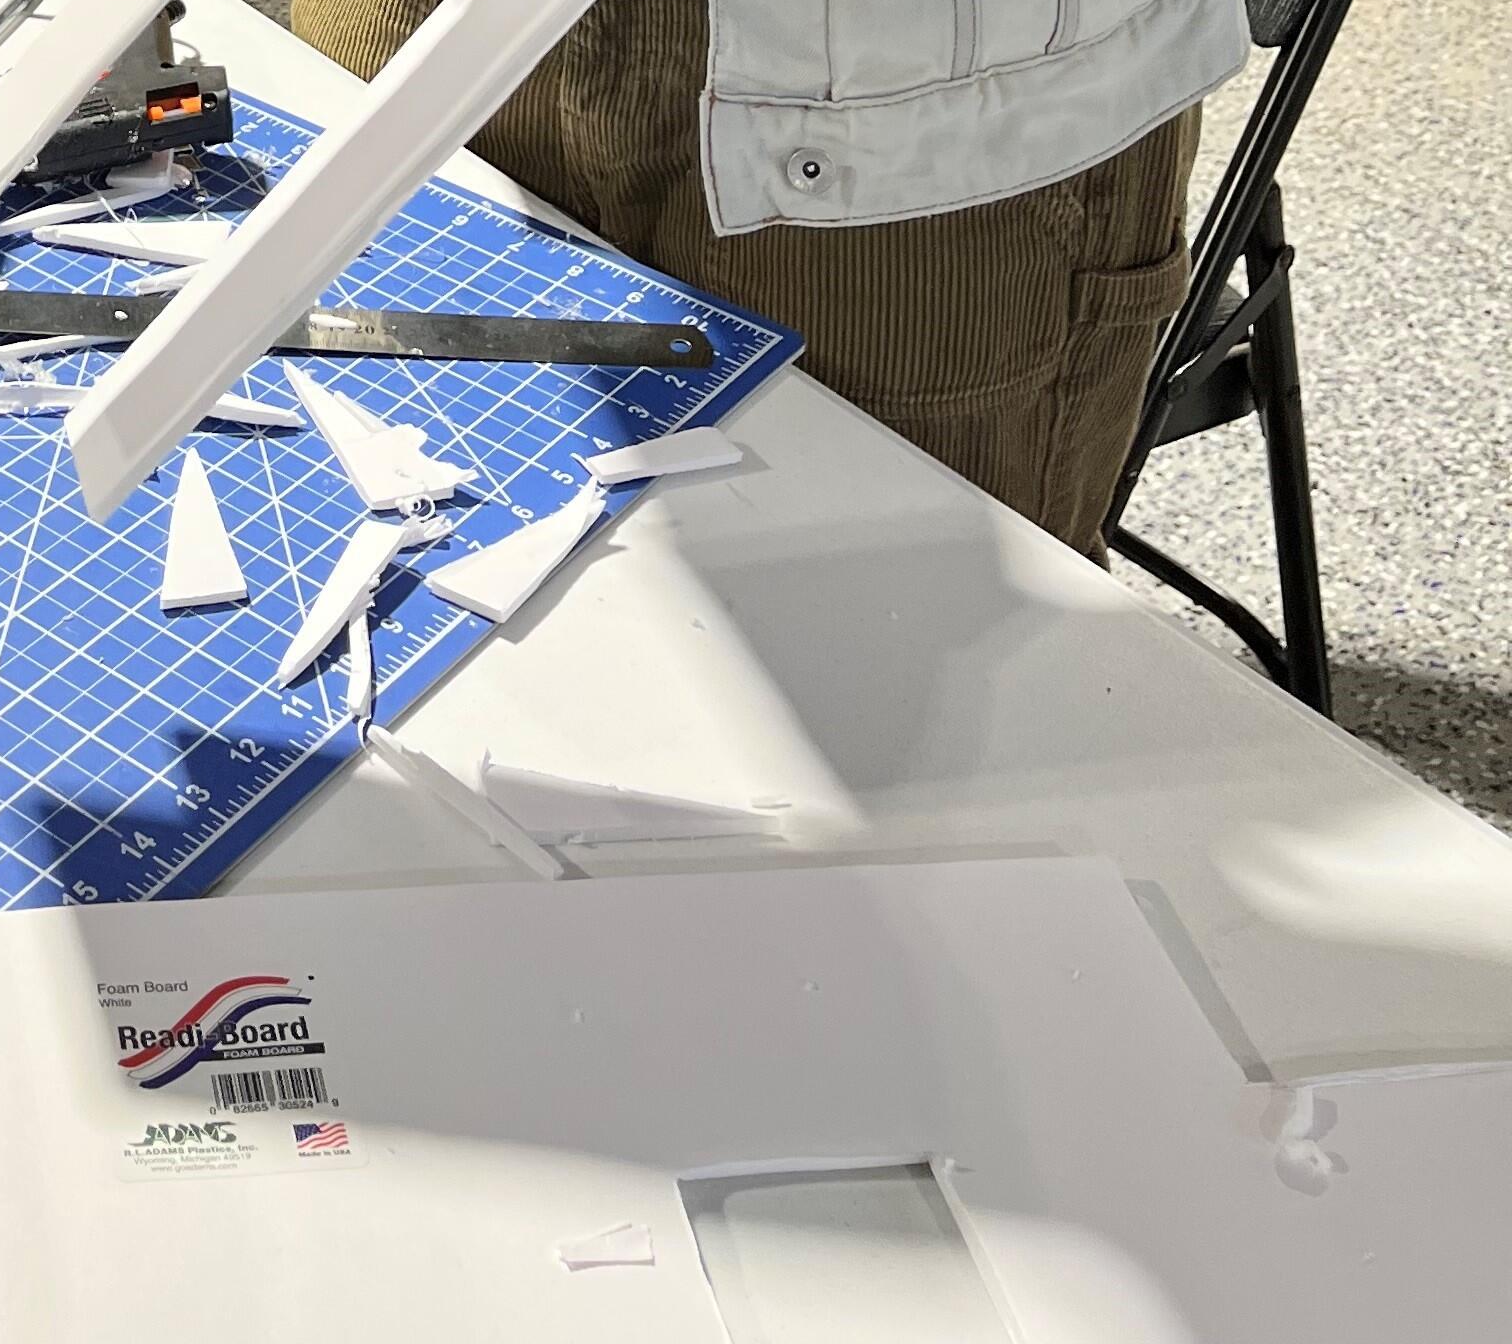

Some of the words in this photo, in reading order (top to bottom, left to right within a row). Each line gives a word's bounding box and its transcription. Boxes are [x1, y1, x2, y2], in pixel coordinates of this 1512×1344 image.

[507, 240, 527, 253] 7
[566, 265, 585, 278] 8
[664, 373, 687, 389] 2
[627, 404, 650, 419] 3
[592, 436, 613, 451] 4
[551, 471, 575, 485] 5
[511, 504, 535, 520] 6
[281, 694, 313, 719] 11
[229, 736, 265, 763] 12
[175, 783, 211, 810] 13
[120, 830, 157, 859] 14
[97, 981, 140, 995] Foam
[144, 979, 189, 994] Board
[99, 998, 132, 1008] White
[117, 1015, 311, 1051] Readi-Board
[223, 1049, 259, 1059] FOAM
[261, 1045, 305, 1056] BOARD
[133, 1121, 237, 1147] ADAMS
